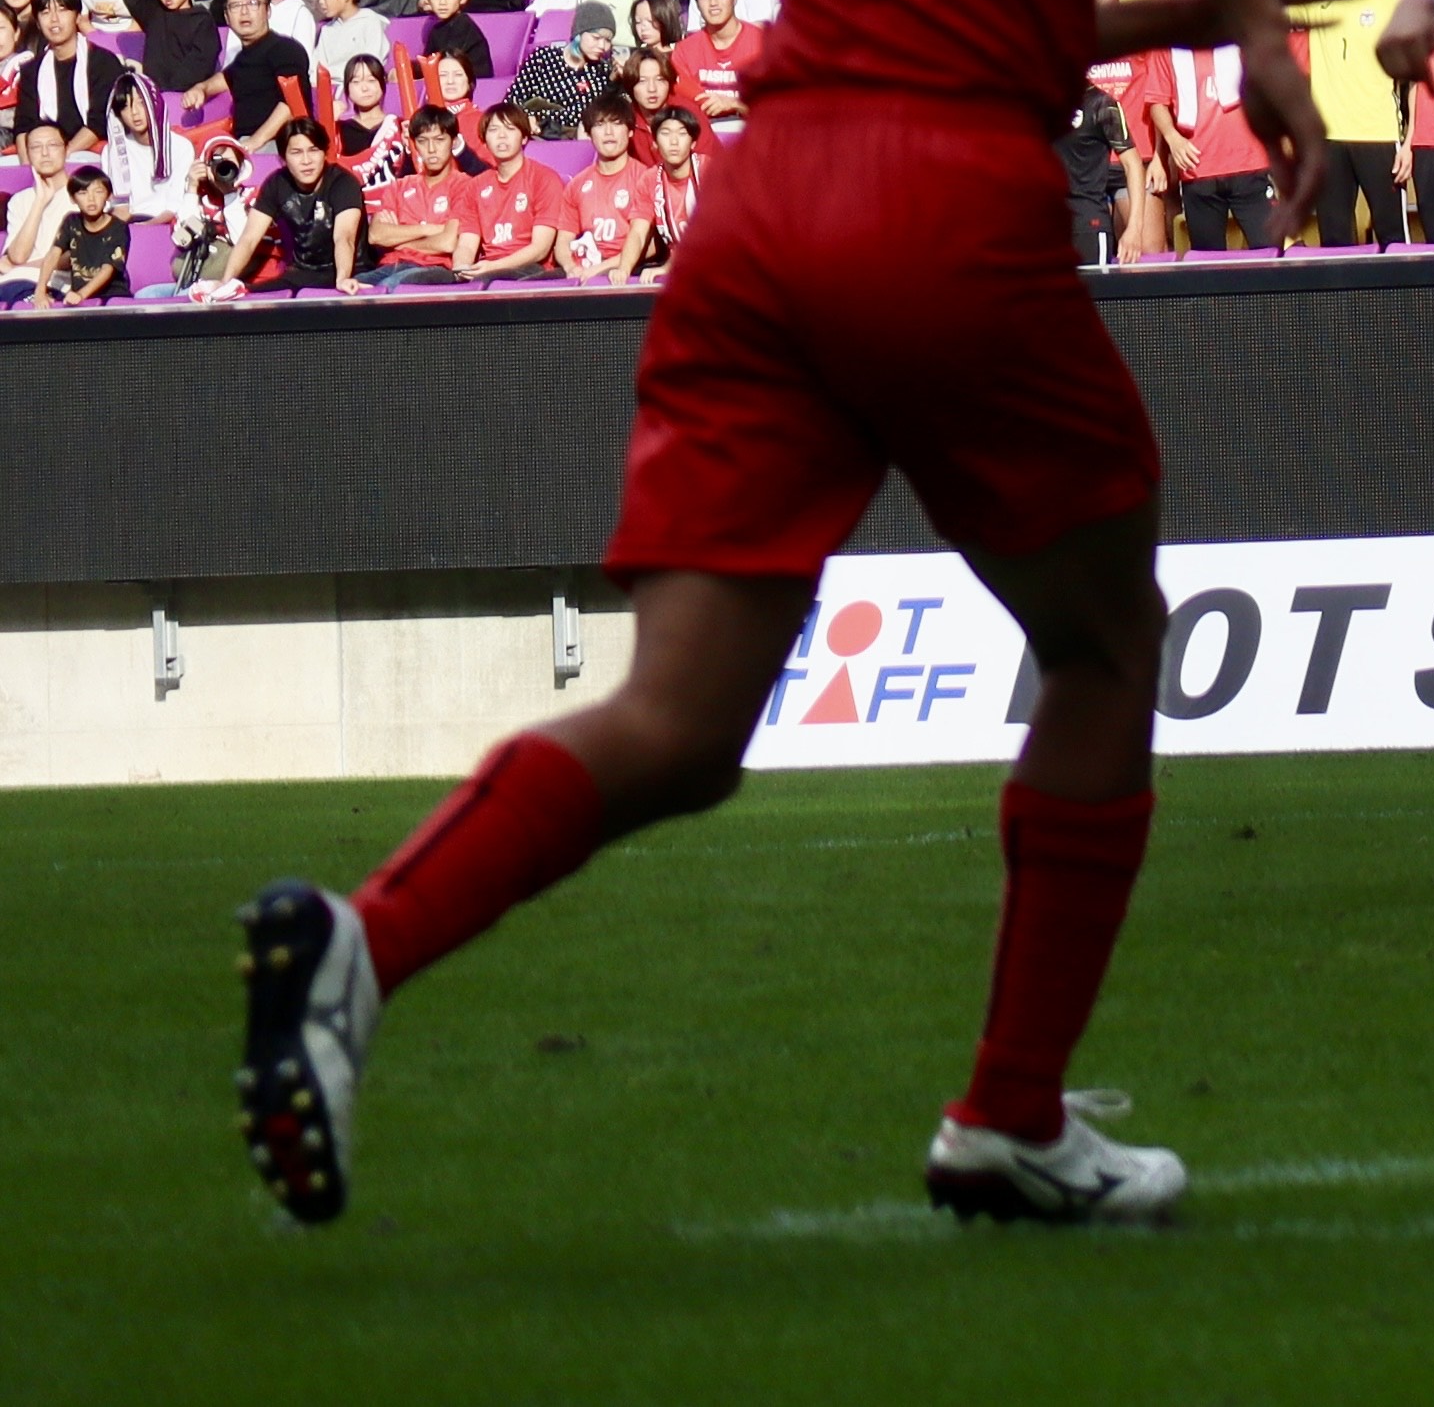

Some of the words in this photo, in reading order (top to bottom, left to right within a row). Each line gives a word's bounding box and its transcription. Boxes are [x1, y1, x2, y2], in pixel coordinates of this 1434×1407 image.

[1087, 62, 1132, 79] SHIYAMA
[593, 217, 617, 242] 20
[1004, 583, 1392, 723] OT
